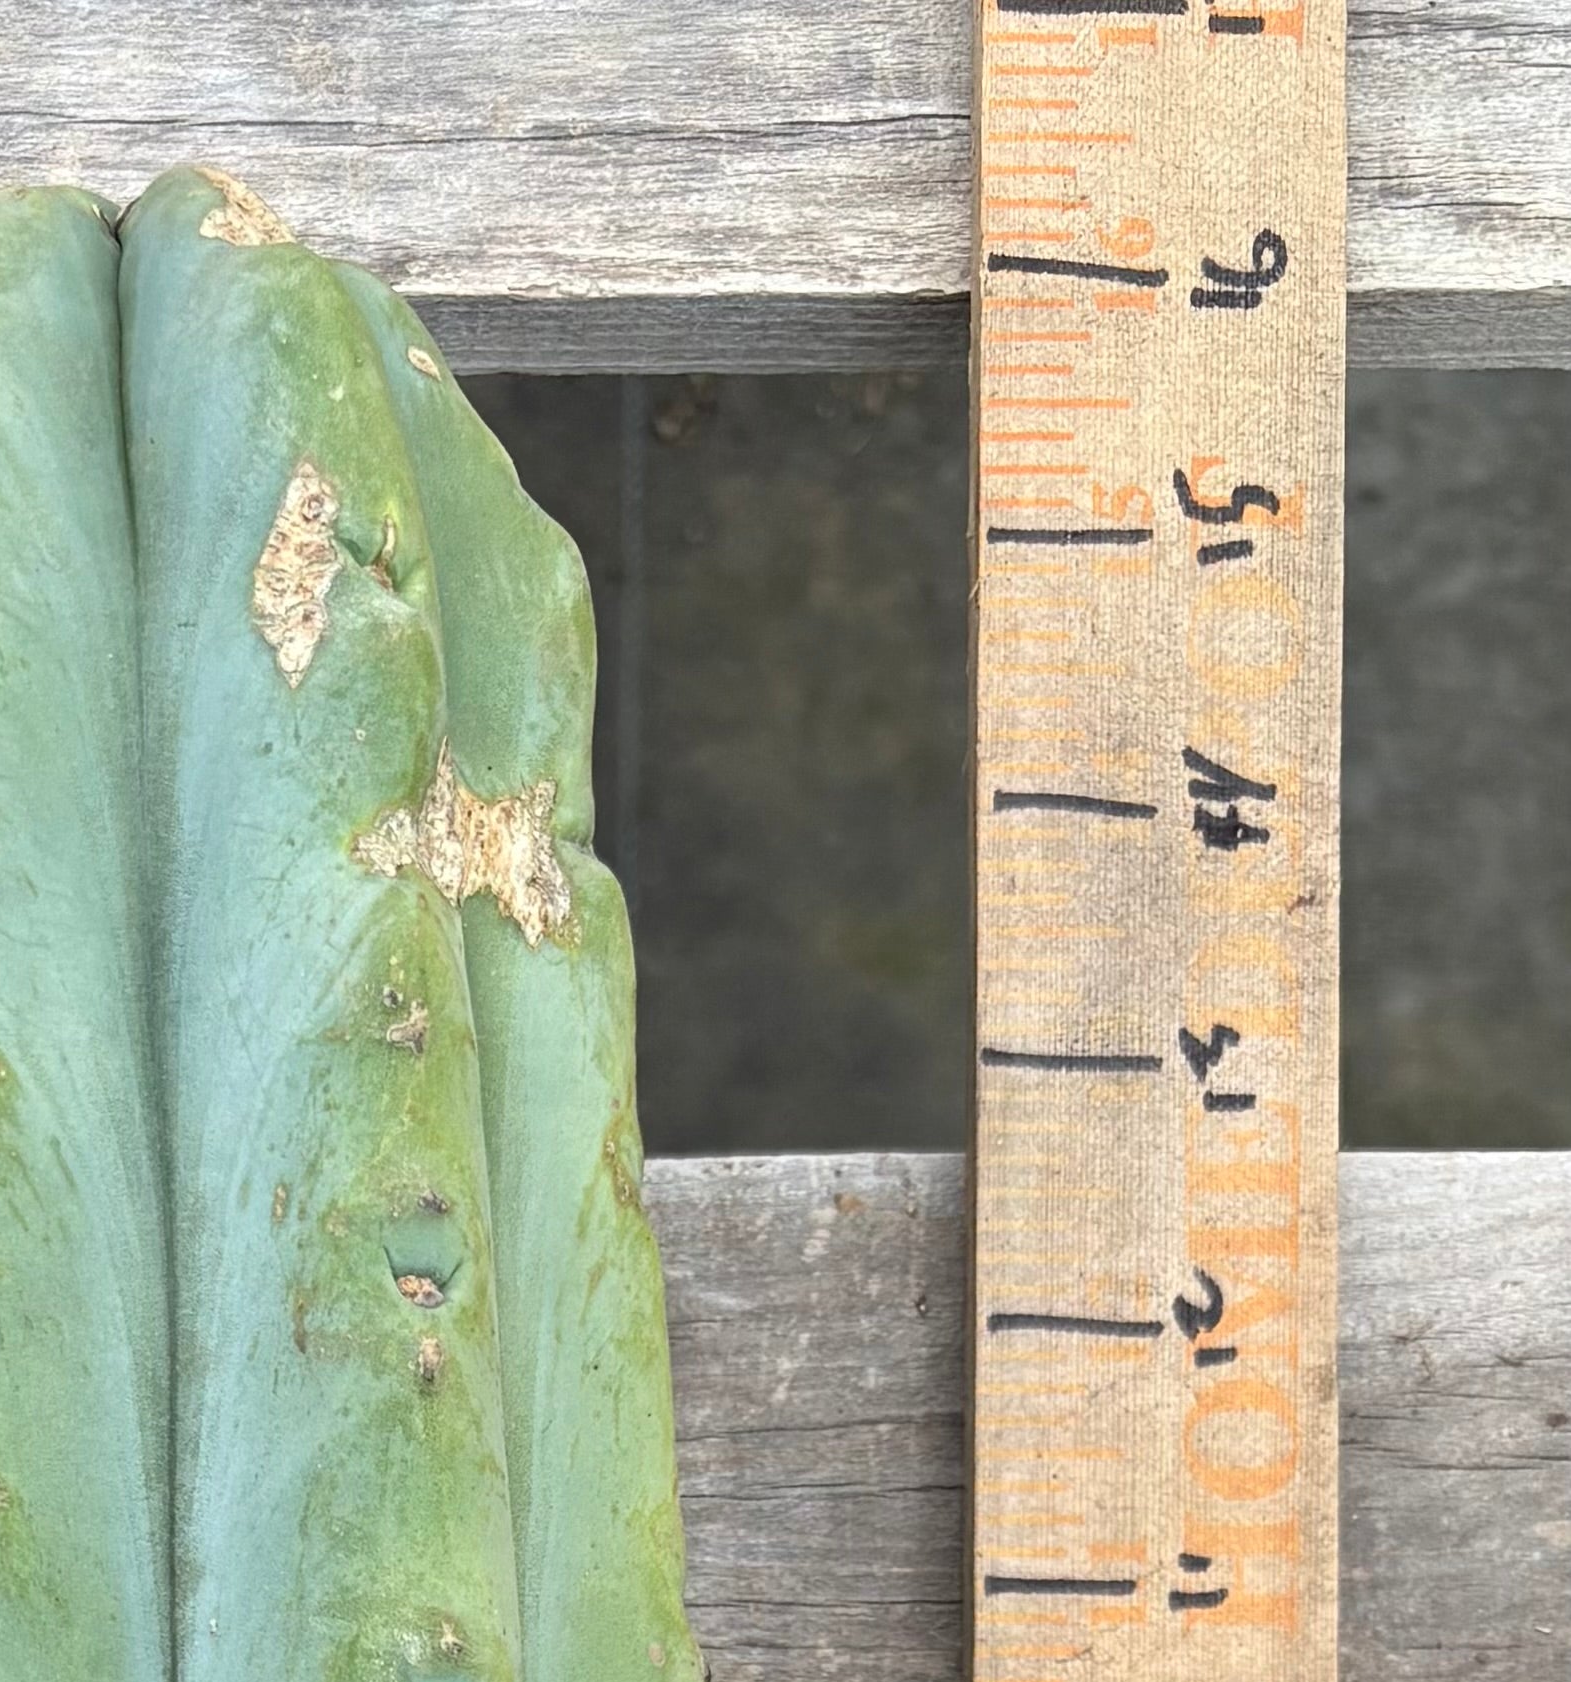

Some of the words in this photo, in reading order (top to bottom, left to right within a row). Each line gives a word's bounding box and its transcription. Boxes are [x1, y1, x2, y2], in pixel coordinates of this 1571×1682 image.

[1189, 227, 1288, 312] 16
[1172, 467, 1280, 567] 15
[1171, 1264, 1239, 1368] 12
[1183, 1098, 1303, 1642] HOME
[1168, 1552, 1229, 1614] 11
